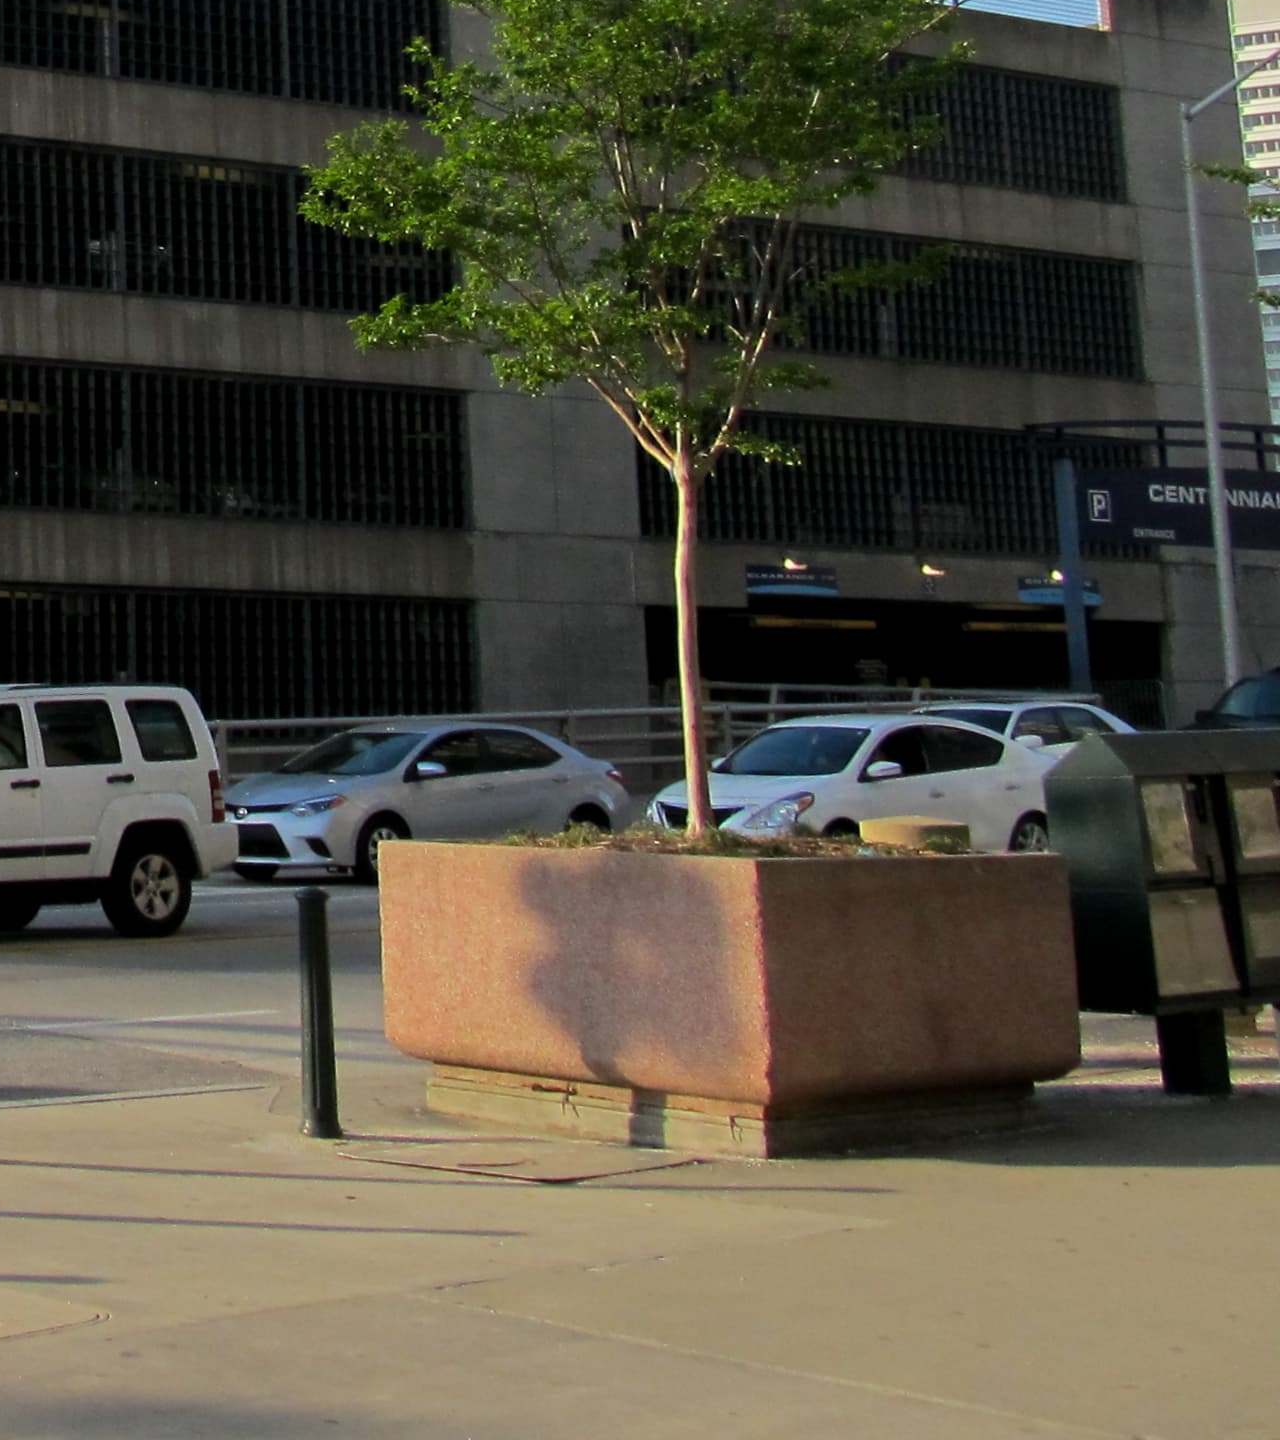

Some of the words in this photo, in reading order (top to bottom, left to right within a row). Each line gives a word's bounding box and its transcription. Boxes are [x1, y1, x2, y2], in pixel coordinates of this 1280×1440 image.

[1091, 493, 1107, 518] P
[1148, 484, 1280, 509] CENTNNIA
[1133, 527, 1175, 540] ENTRANCE
